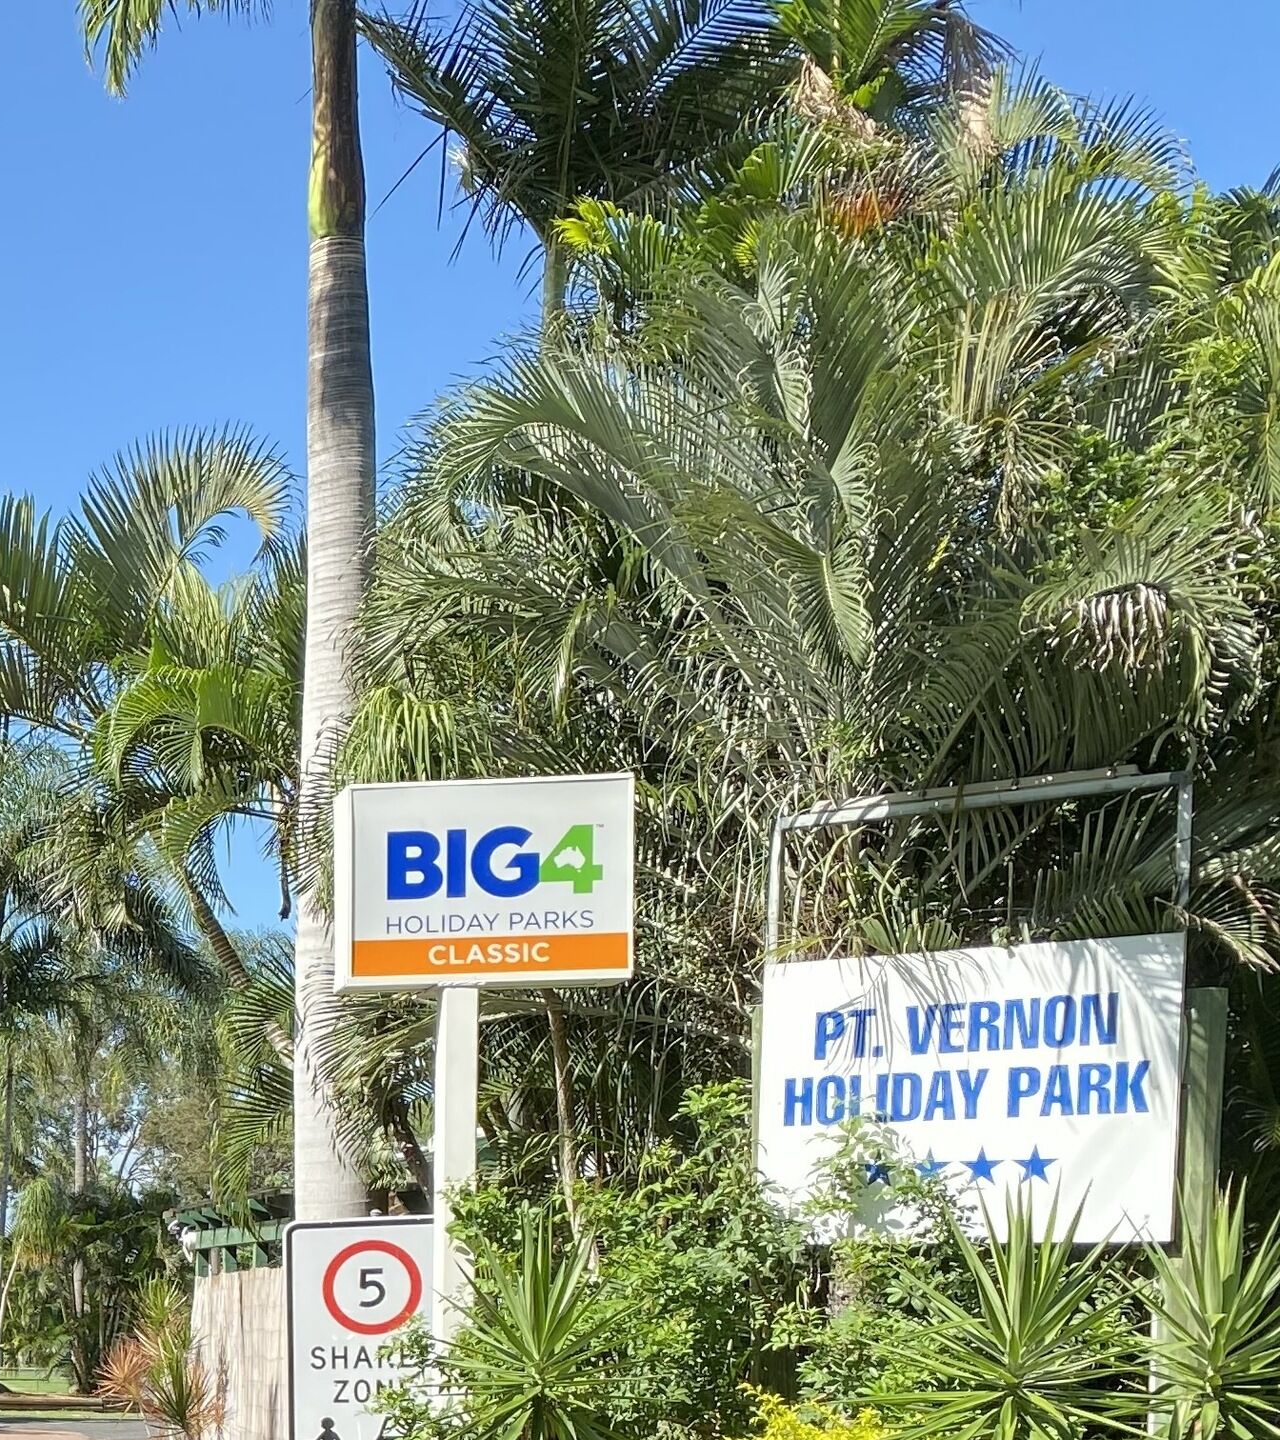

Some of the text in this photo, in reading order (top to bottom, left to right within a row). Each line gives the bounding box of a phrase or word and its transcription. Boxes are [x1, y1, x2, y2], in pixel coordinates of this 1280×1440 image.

[386, 824, 603, 900] BIG4
[386, 910, 594, 934] HOLIDAY PARKS
[428, 942, 551, 965] CLASSIC
[813, 992, 1119, 1060] PT. VERNON
[783, 1060, 1151, 1127] HOLIDAY PARK
[358, 1268, 386, 1308] 5
[310, 1345, 435, 1370] SHARE
